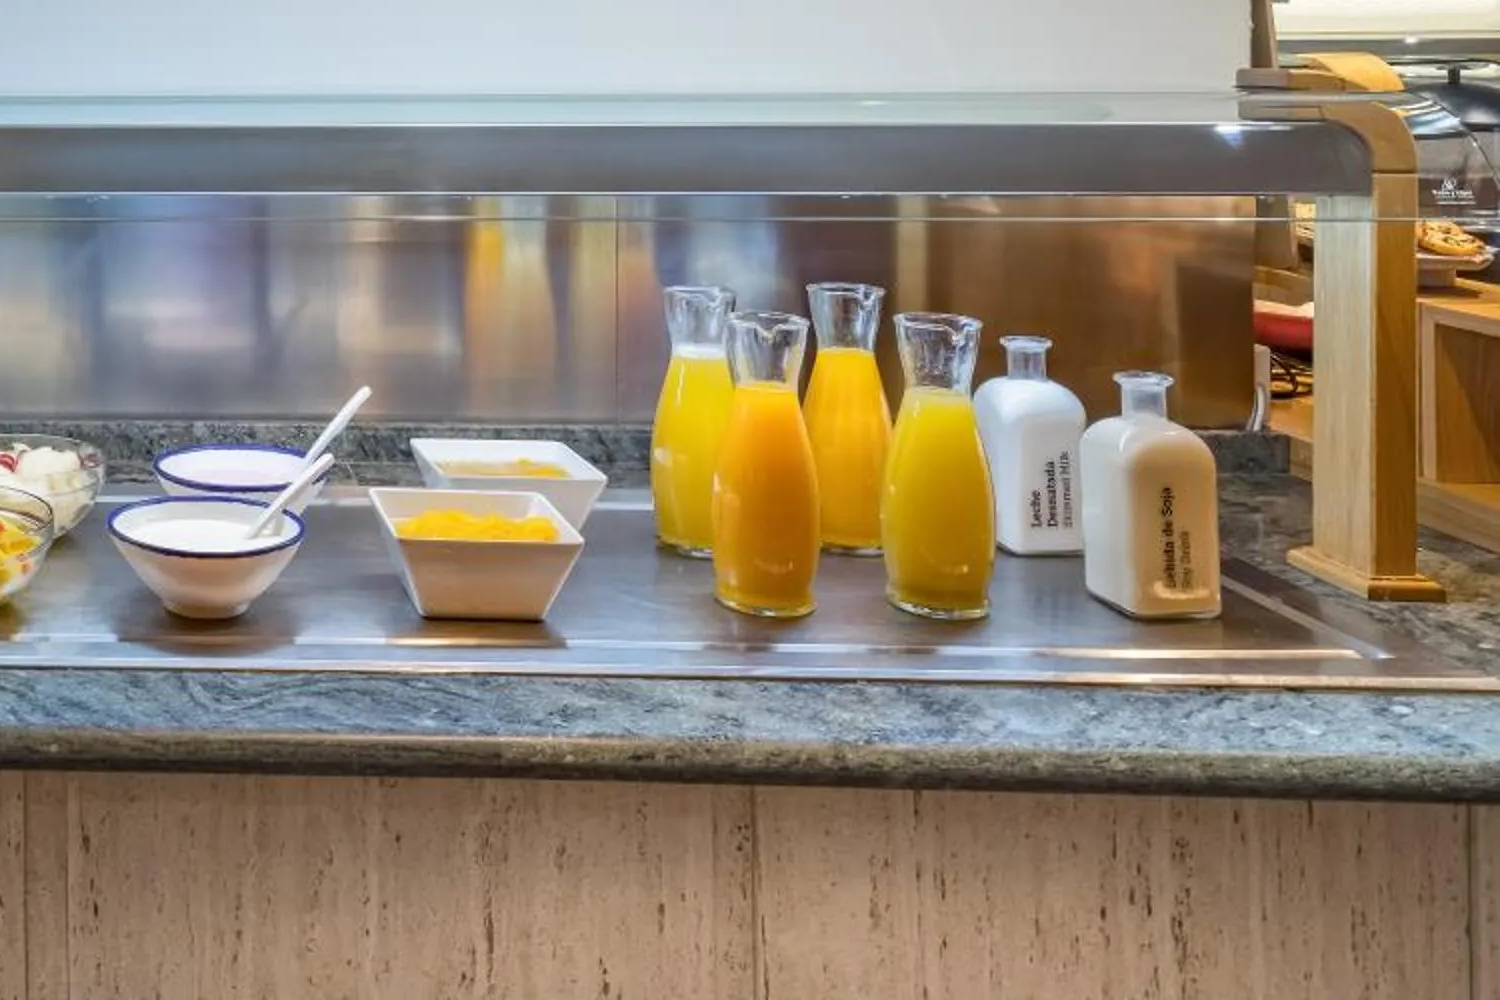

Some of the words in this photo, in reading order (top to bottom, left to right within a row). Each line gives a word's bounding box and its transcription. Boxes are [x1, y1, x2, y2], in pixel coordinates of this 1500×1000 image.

[1030, 490, 1042, 528] Leche
[1160, 487, 1176, 517] Soja
[1161, 520, 1174, 537] de
